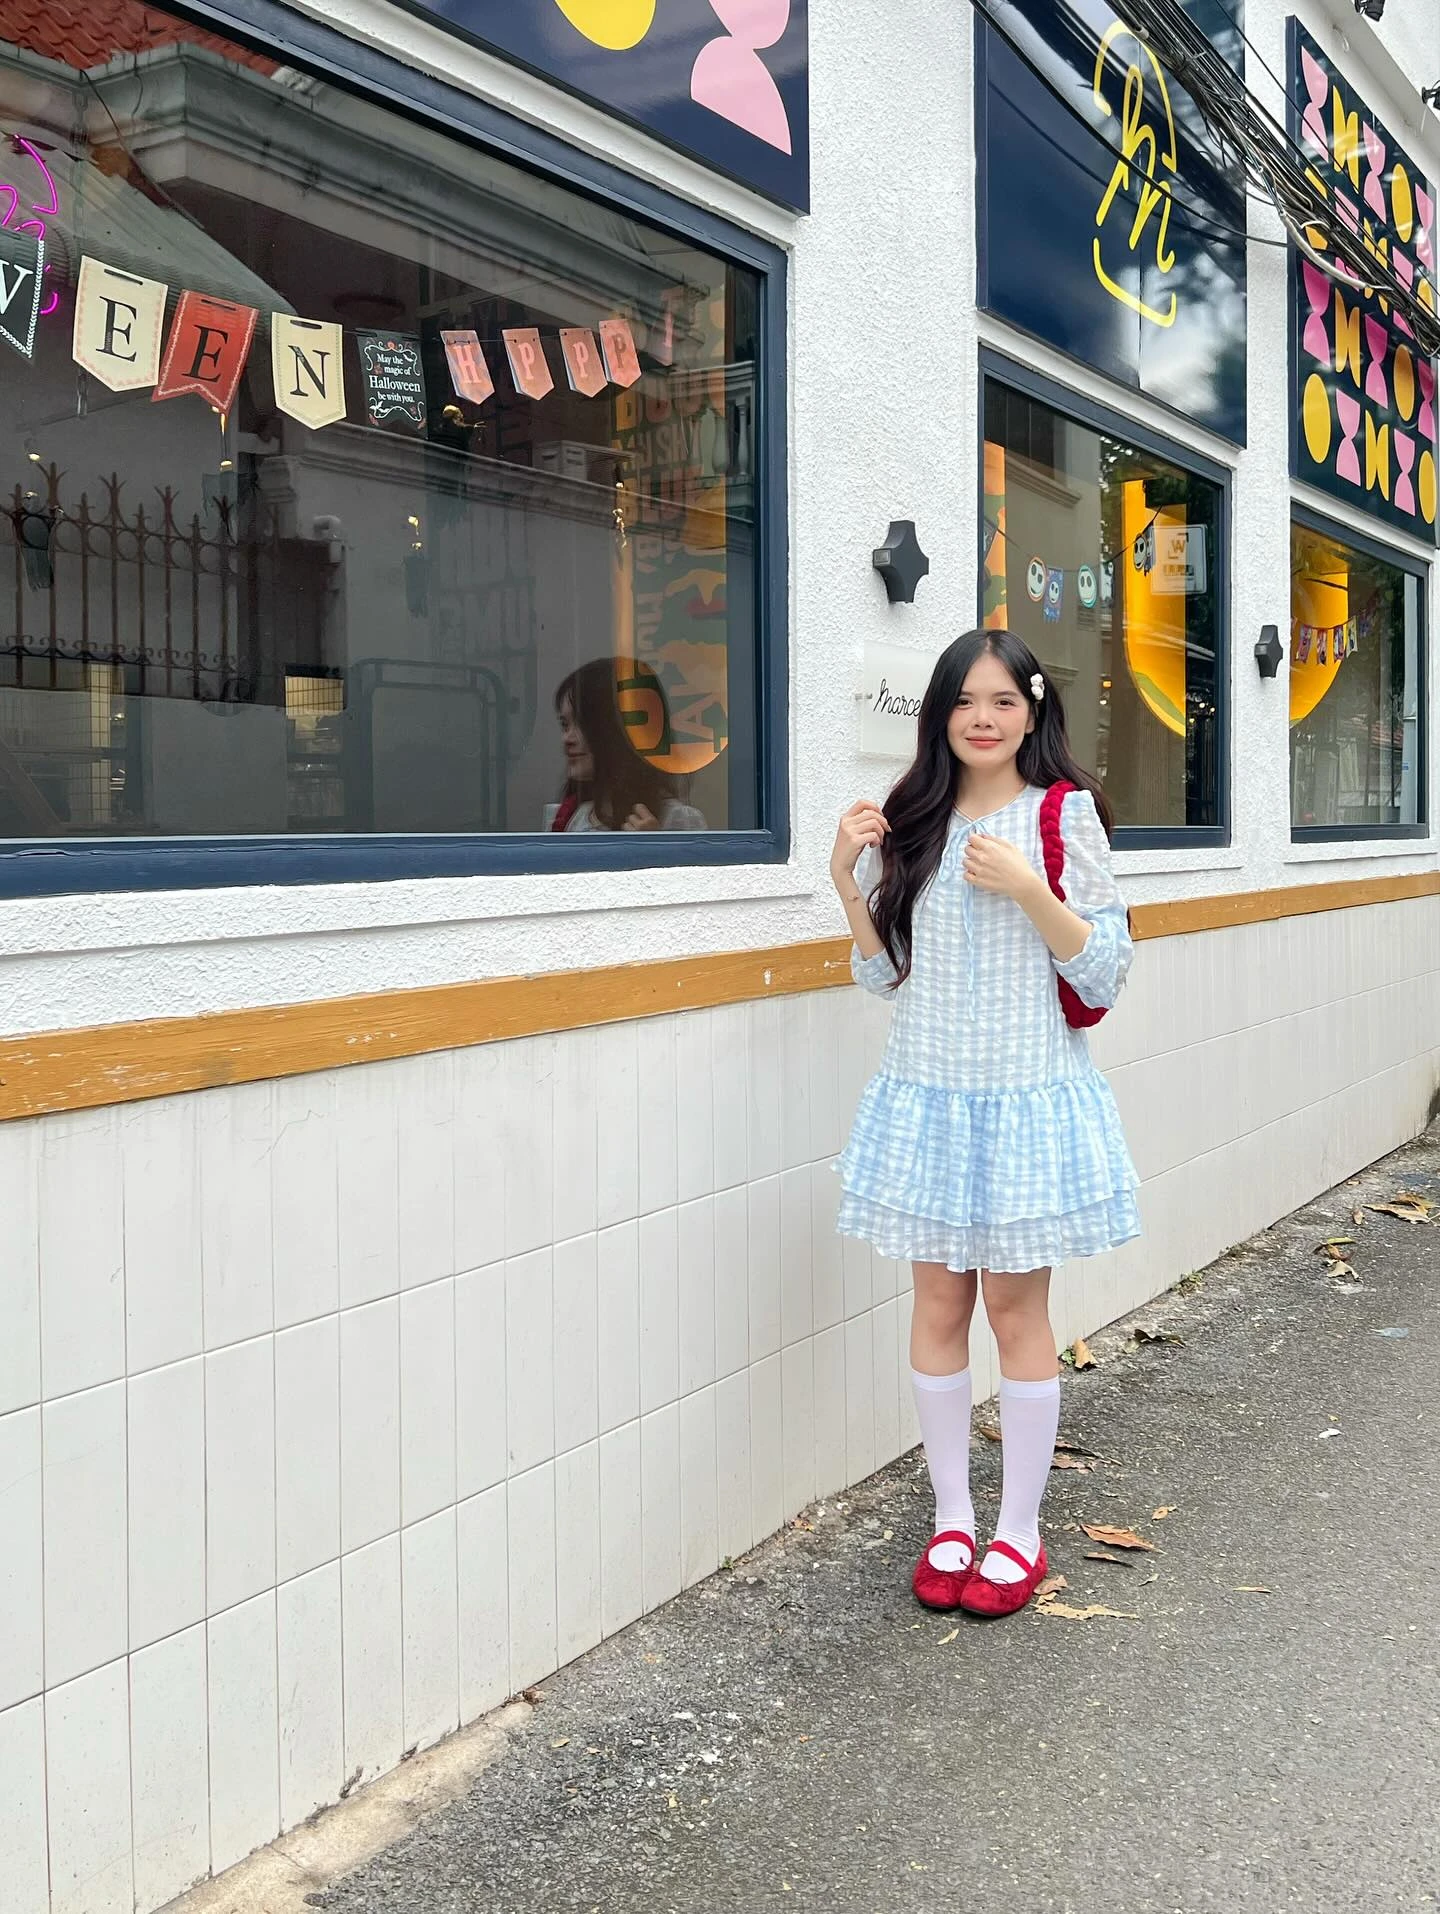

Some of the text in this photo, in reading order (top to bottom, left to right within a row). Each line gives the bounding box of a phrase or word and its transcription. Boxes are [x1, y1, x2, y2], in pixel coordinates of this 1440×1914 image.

[377, 354, 403, 365] May the
[384, 366, 412, 376] magic of
[369, 375, 421, 392] Halloween
[377, 391, 386, 400] be
[387, 392, 401, 401] with
